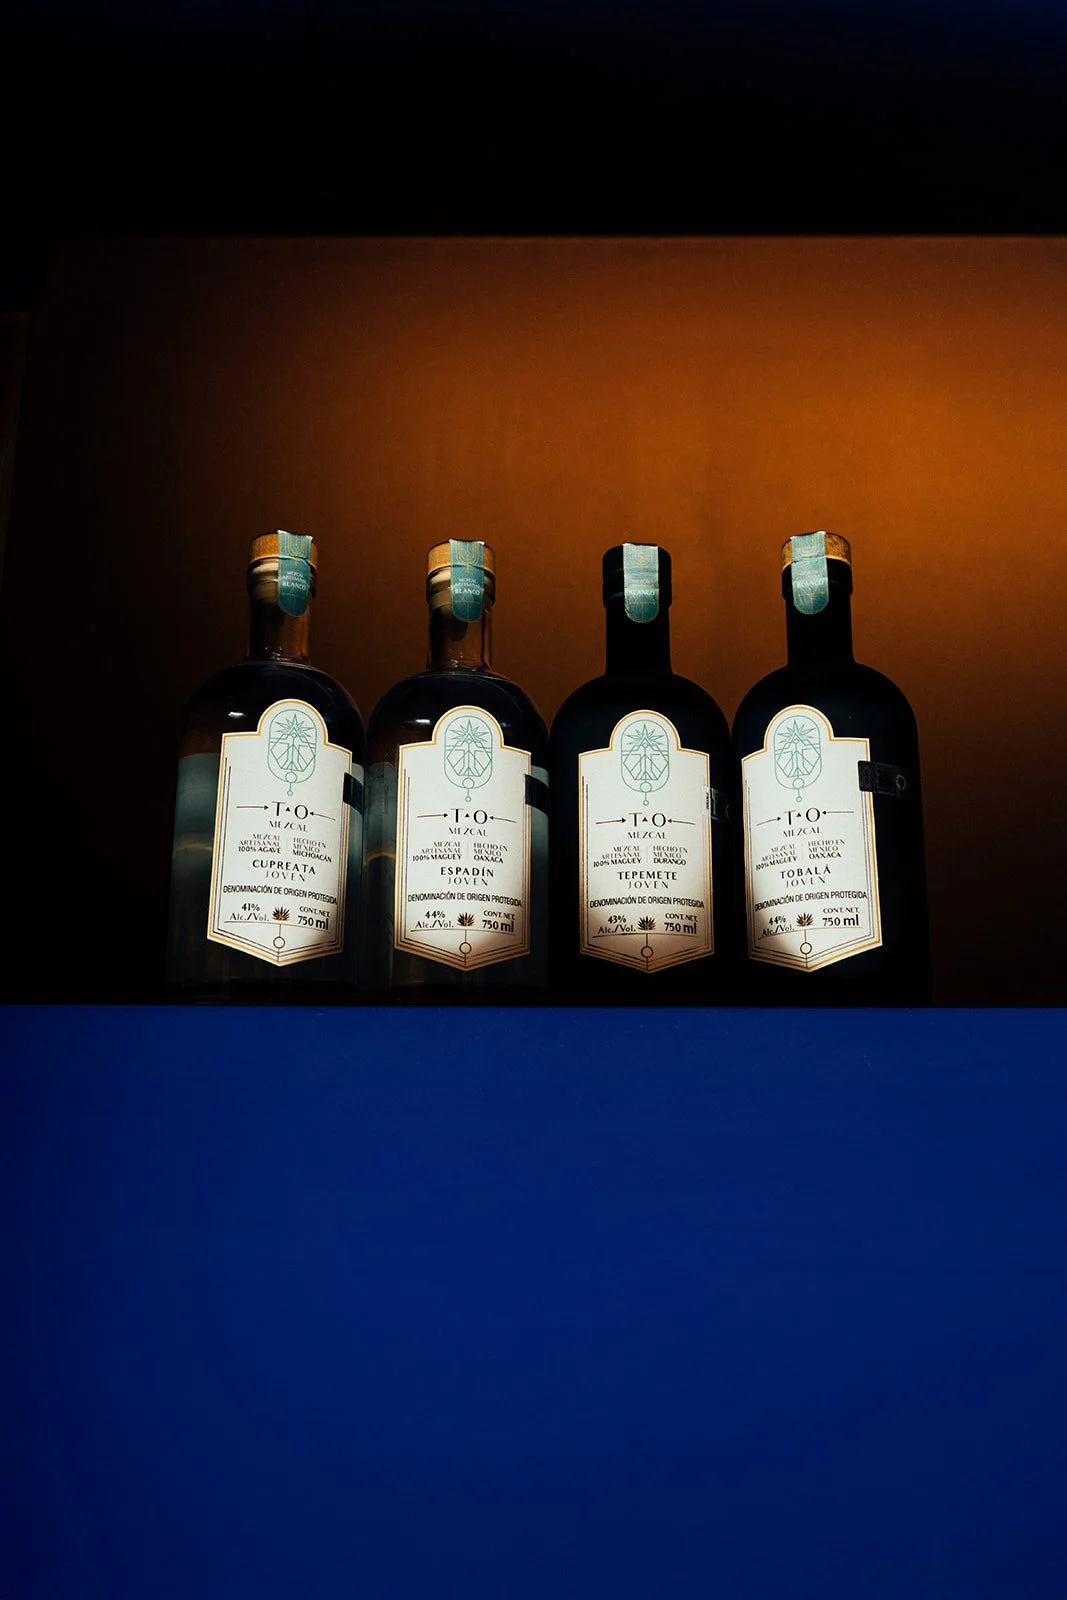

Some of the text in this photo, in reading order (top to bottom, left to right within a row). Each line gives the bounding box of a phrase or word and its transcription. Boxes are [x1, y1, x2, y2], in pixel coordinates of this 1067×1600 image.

[269, 820, 308, 832] MEZCAL
[449, 827, 488, 836] MEZCAL
[628, 831, 667, 839] MEZCAL
[783, 826, 821, 837] MEZCAL
[294, 837, 317, 847] HECHO
[771, 844, 796, 853] MEZCAL
[474, 855, 503, 863] OAXACA
[756, 855, 798, 870] 100% MAGUEY
[252, 860, 316, 874] CUPREATA
[441, 867, 494, 877] ESPADÍN
[780, 864, 831, 879] TOBALÁ
[266, 871, 305, 882] JOVEN
[617, 871, 677, 880] TEPEMETE
[448, 877, 488, 886] JOVEN
[628, 881, 669, 889] JOVEN
[786, 876, 825, 888] JOVEN
[223, 885, 272, 893] DENOMINACIÓN
[284, 888, 307, 898] ORIGEN
[308, 892, 337, 905] PROTEGIDA
[408, 891, 456, 902] DENOMINACIÓN
[467, 893, 490, 902] ORIGEN
[492, 895, 522, 907] PROTEGIDA
[590, 895, 636, 908] DENOMINACIÓN
[673, 897, 704, 908] PROTEGIDA
[755, 891, 867, 912] DENOMINACIÓN DE ORIGEN PROTEGIDA
[241, 903, 260, 911] 41%
[230, 913, 269, 921] Alc./Vol.
[608, 915, 626, 923] 43%
[769, 916, 786, 925] 44%
[822, 914, 859, 926] 750 ml
[298, 916, 329, 930] 750 ml
[415, 920, 454, 928] Alc./Vol.
[482, 920, 514, 932] 750 ml
[664, 922, 696, 934] 750 ml
[598, 925, 636, 934] Alc./Vol.
